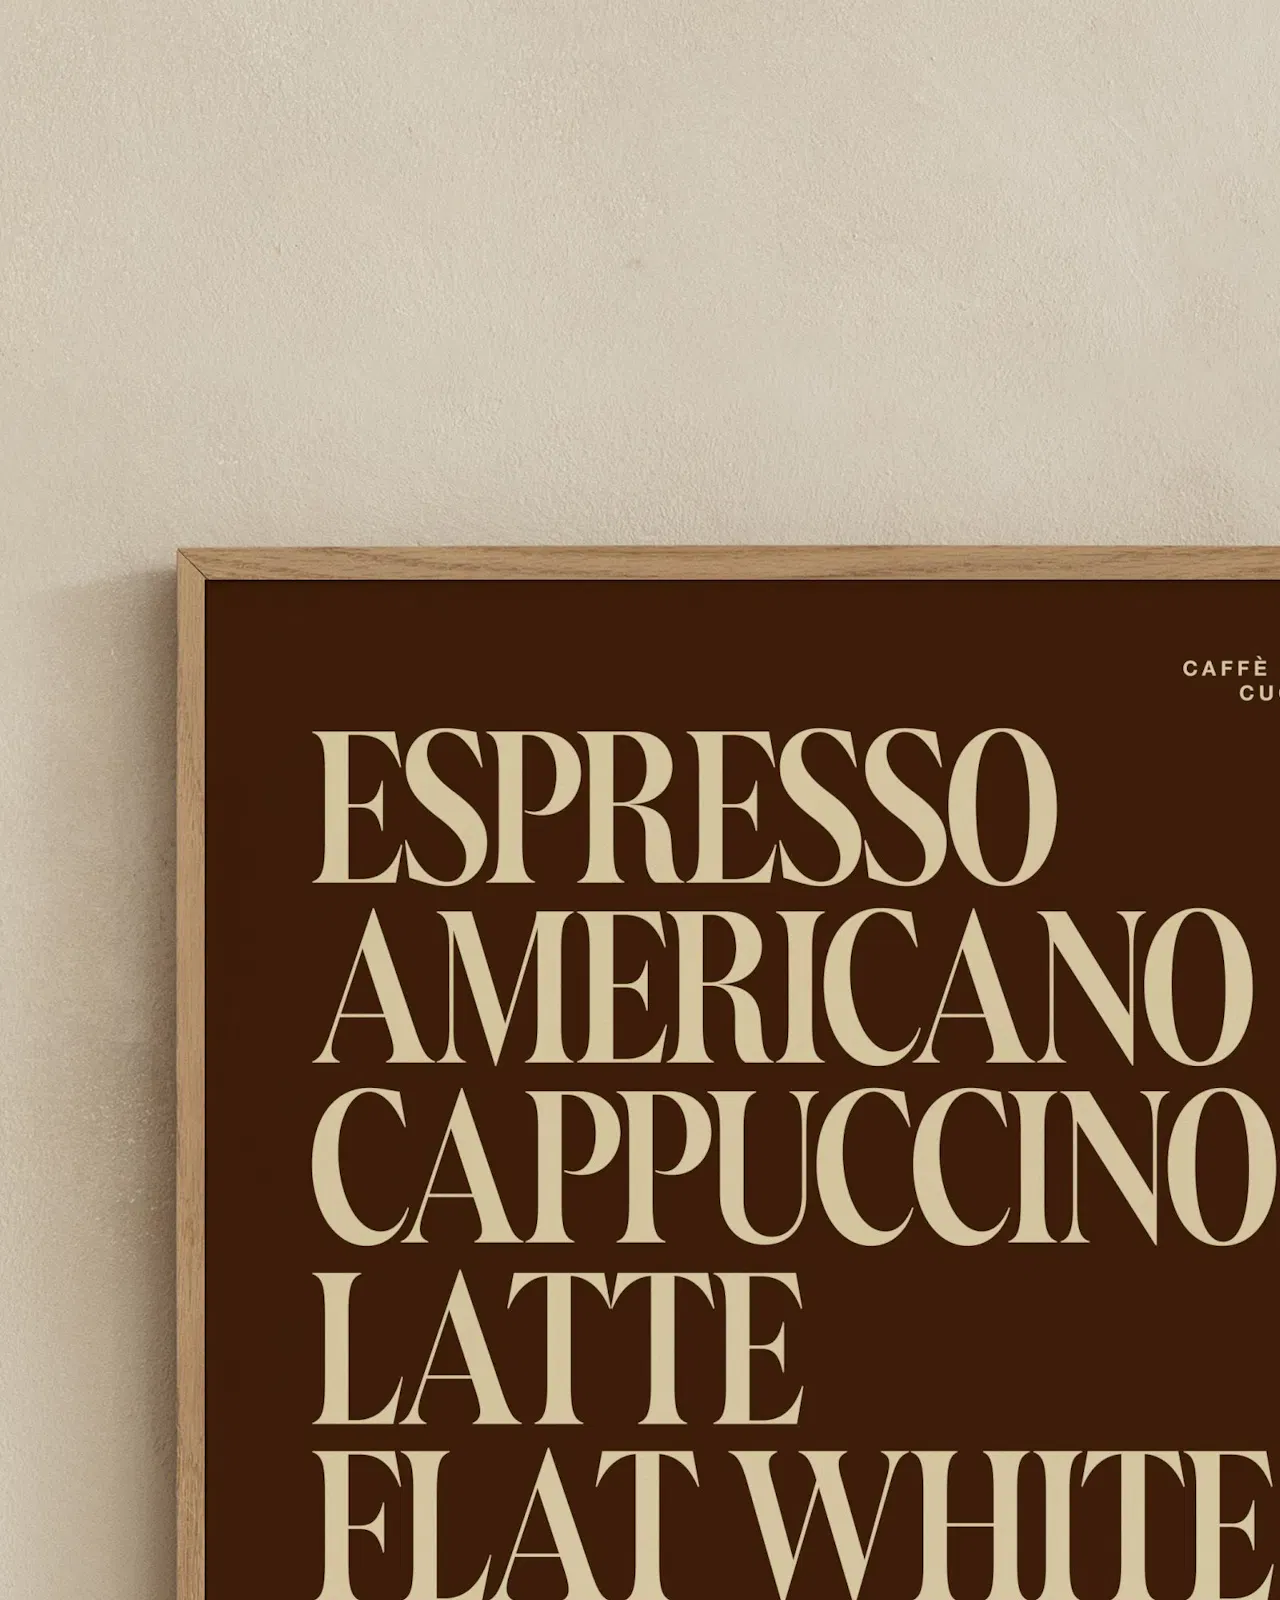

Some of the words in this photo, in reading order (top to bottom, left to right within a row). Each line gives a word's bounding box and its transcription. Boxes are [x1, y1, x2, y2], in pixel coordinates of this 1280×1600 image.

[1182, 655, 1268, 677] CAFFÈ
[312, 727, 1058, 887] ESPRESSO
[312, 907, 1254, 1067] AMERICANO
[311, 1087, 1277, 1247] CAPPUCCINO
[312, 1269, 804, 1425] LATTE
